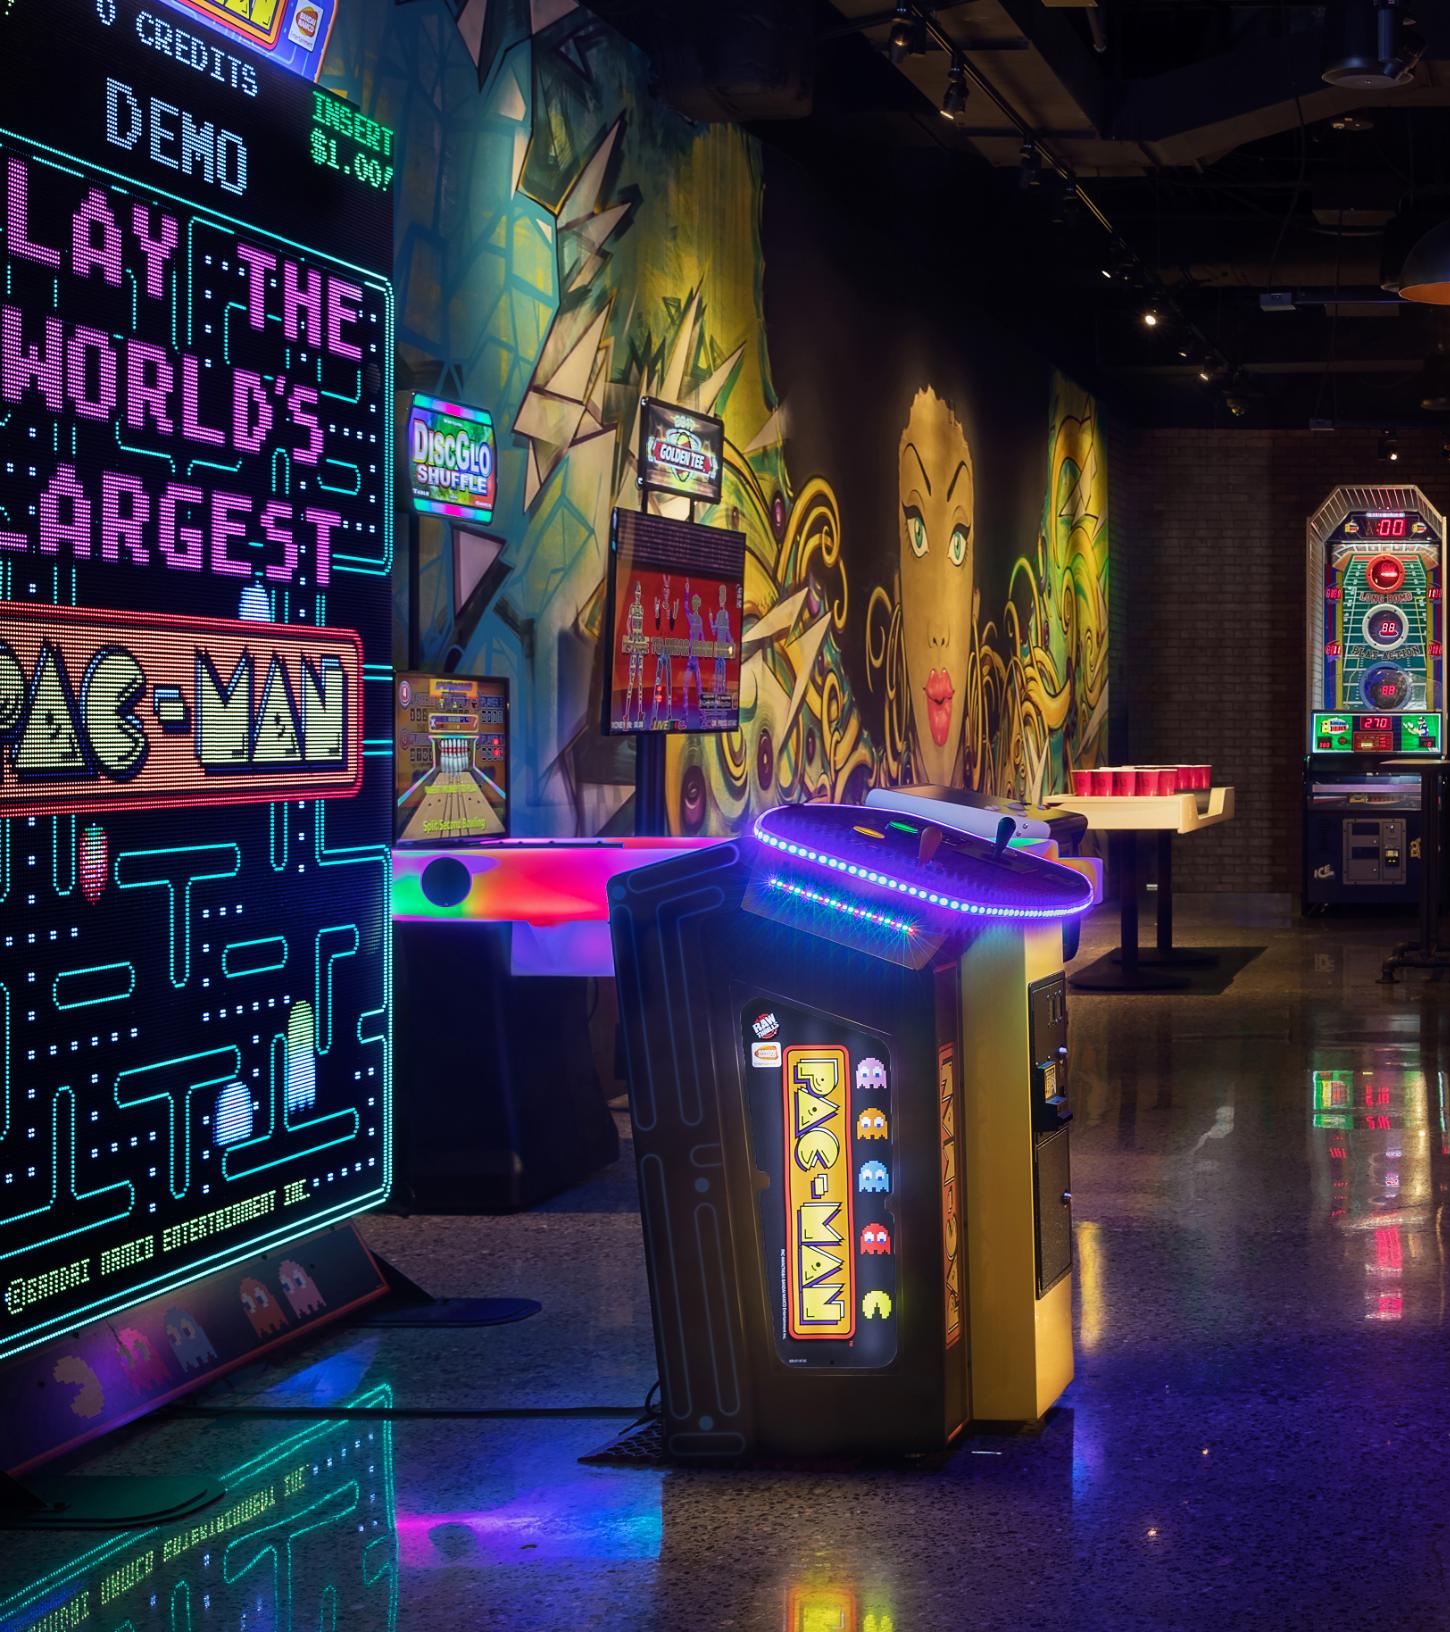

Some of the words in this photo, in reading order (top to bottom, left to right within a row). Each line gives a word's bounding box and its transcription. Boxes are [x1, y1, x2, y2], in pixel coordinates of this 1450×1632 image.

[136, 11, 258, 97] CREDITS
[106, 77, 248, 195] DEMO
[311, 90, 394, 156] INSERT
[309, 128, 394, 192] $1.00!
[237, 242, 363, 362] THE
[1, 305, 325, 467] WORLD'S
[416, 463, 489, 496] SHUFFLE
[660, 444, 691, 466] GOLDEN
[690, 452, 705, 469] TEE
[1359, 591, 1385, 604] LONG
[1386, 591, 1413, 603] BOMB
[1364, 718, 1388, 728] 270
[1313, 864, 1335, 879] ICE
[751, 1013, 776, 1034] RAW
[794, 1058, 846, 1327] PAC-MAN
[939, 1055, 960, 1336] PAC-MAN
[101, 1235, 154, 1276] NAMCO
[162, 1190, 277, 1253] ENTERTAINMENT
